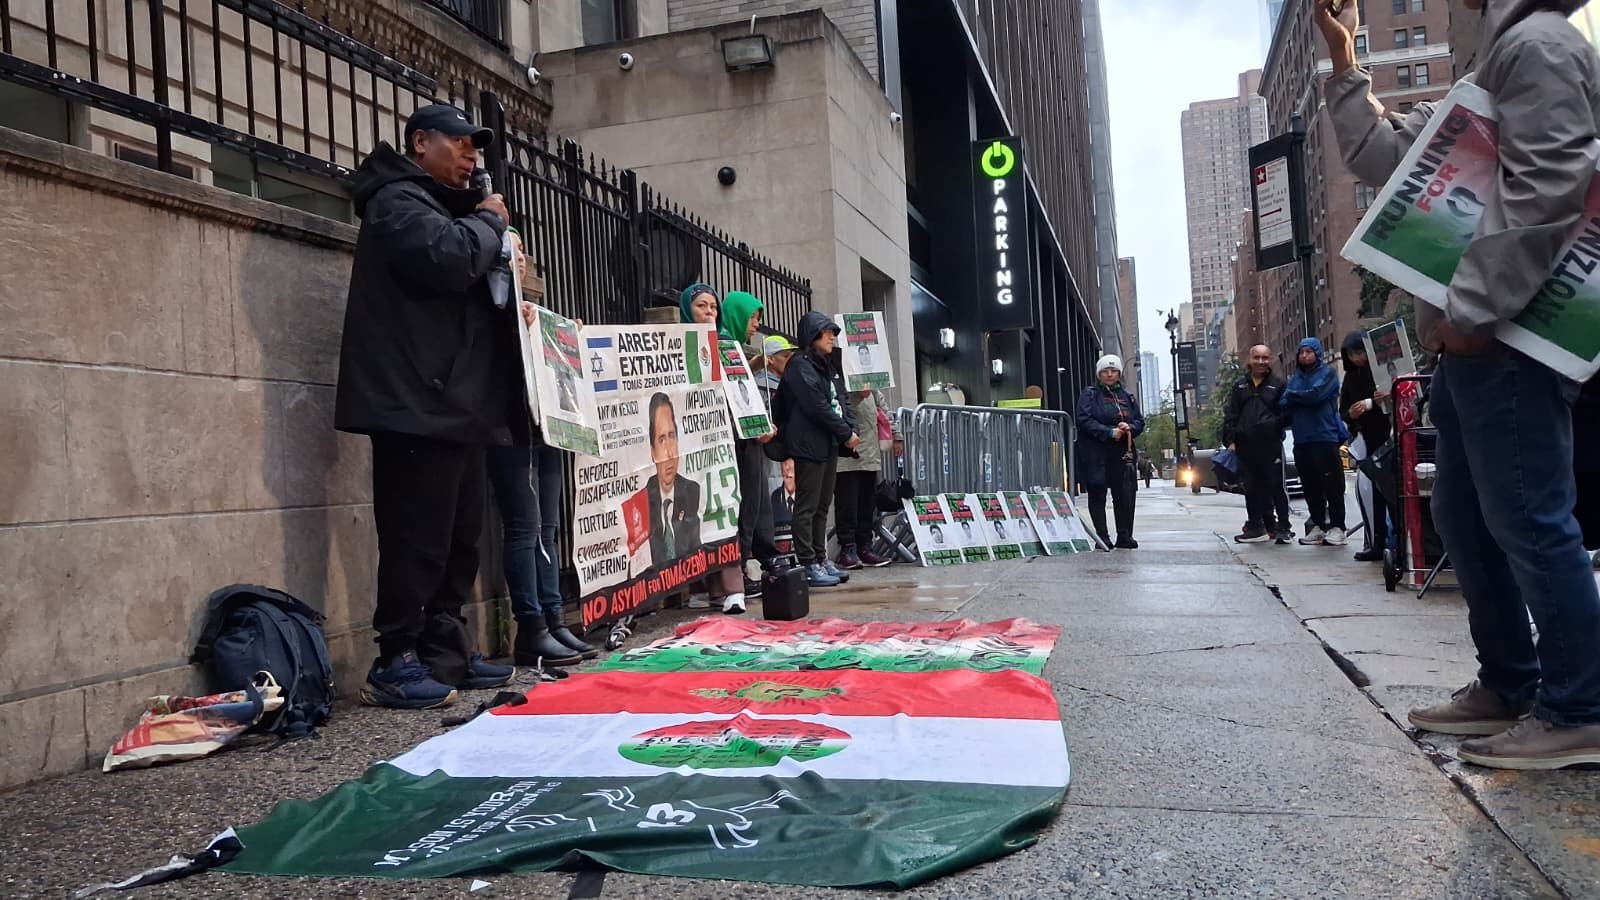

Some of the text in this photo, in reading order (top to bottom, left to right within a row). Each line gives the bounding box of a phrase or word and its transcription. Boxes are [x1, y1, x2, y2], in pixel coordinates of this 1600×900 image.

[1373, 113, 1471, 241] RUNNING
[1415, 163, 1459, 213] FOR
[993, 178, 1014, 305] PARKING
[618, 331, 682, 353] ARREST AND
[619, 353, 685, 377] EXTRADITE
[578, 460, 619, 486] ENFORCED
[703, 466, 742, 530] 43
[577, 510, 619, 535] TORTURE
[577, 537, 621, 564] EVIDENCE
[582, 595, 608, 627] NO
[409, 830, 457, 850] SON
[443, 818, 476, 829] IS
[460, 791, 515, 818] YOUR
